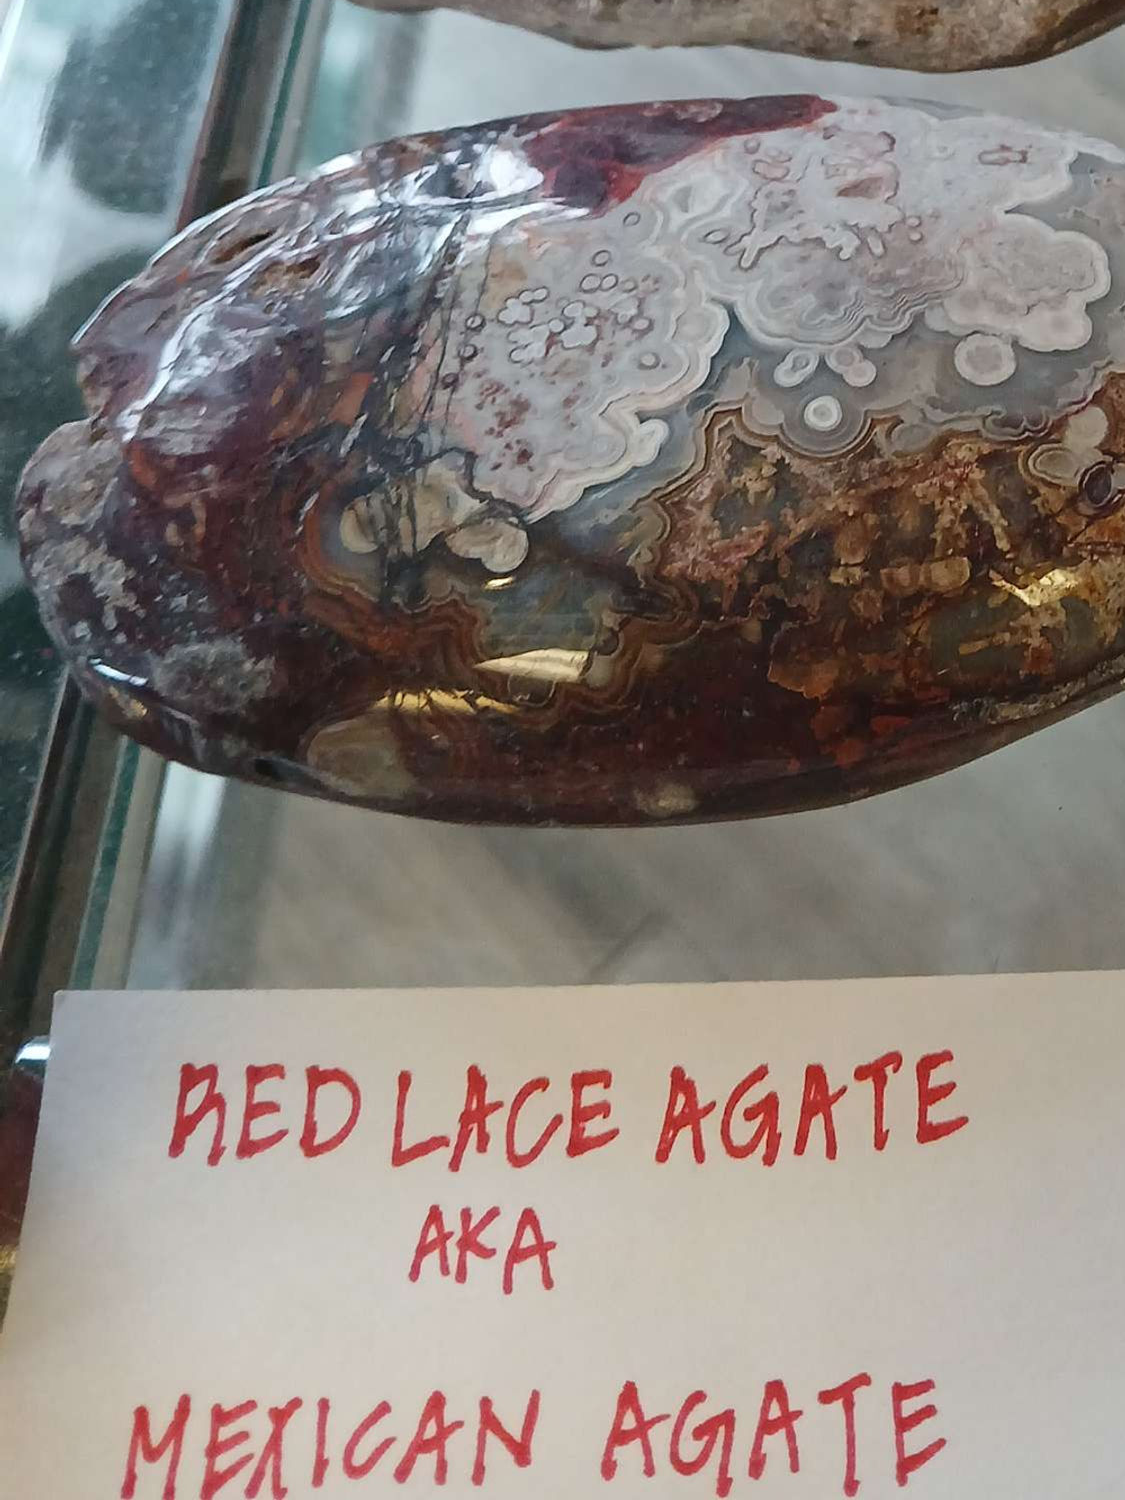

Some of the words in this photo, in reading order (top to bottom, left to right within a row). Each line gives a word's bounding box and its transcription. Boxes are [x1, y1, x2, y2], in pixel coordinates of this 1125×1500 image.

[168, 1062, 362, 1168] RED
[390, 1063, 622, 1174] LACE
[653, 1048, 970, 1169] AGATE
[407, 1203, 558, 1297] AKA
[118, 1390, 543, 1500] MEXICAN
[600, 1372, 948, 1500] AGATE
